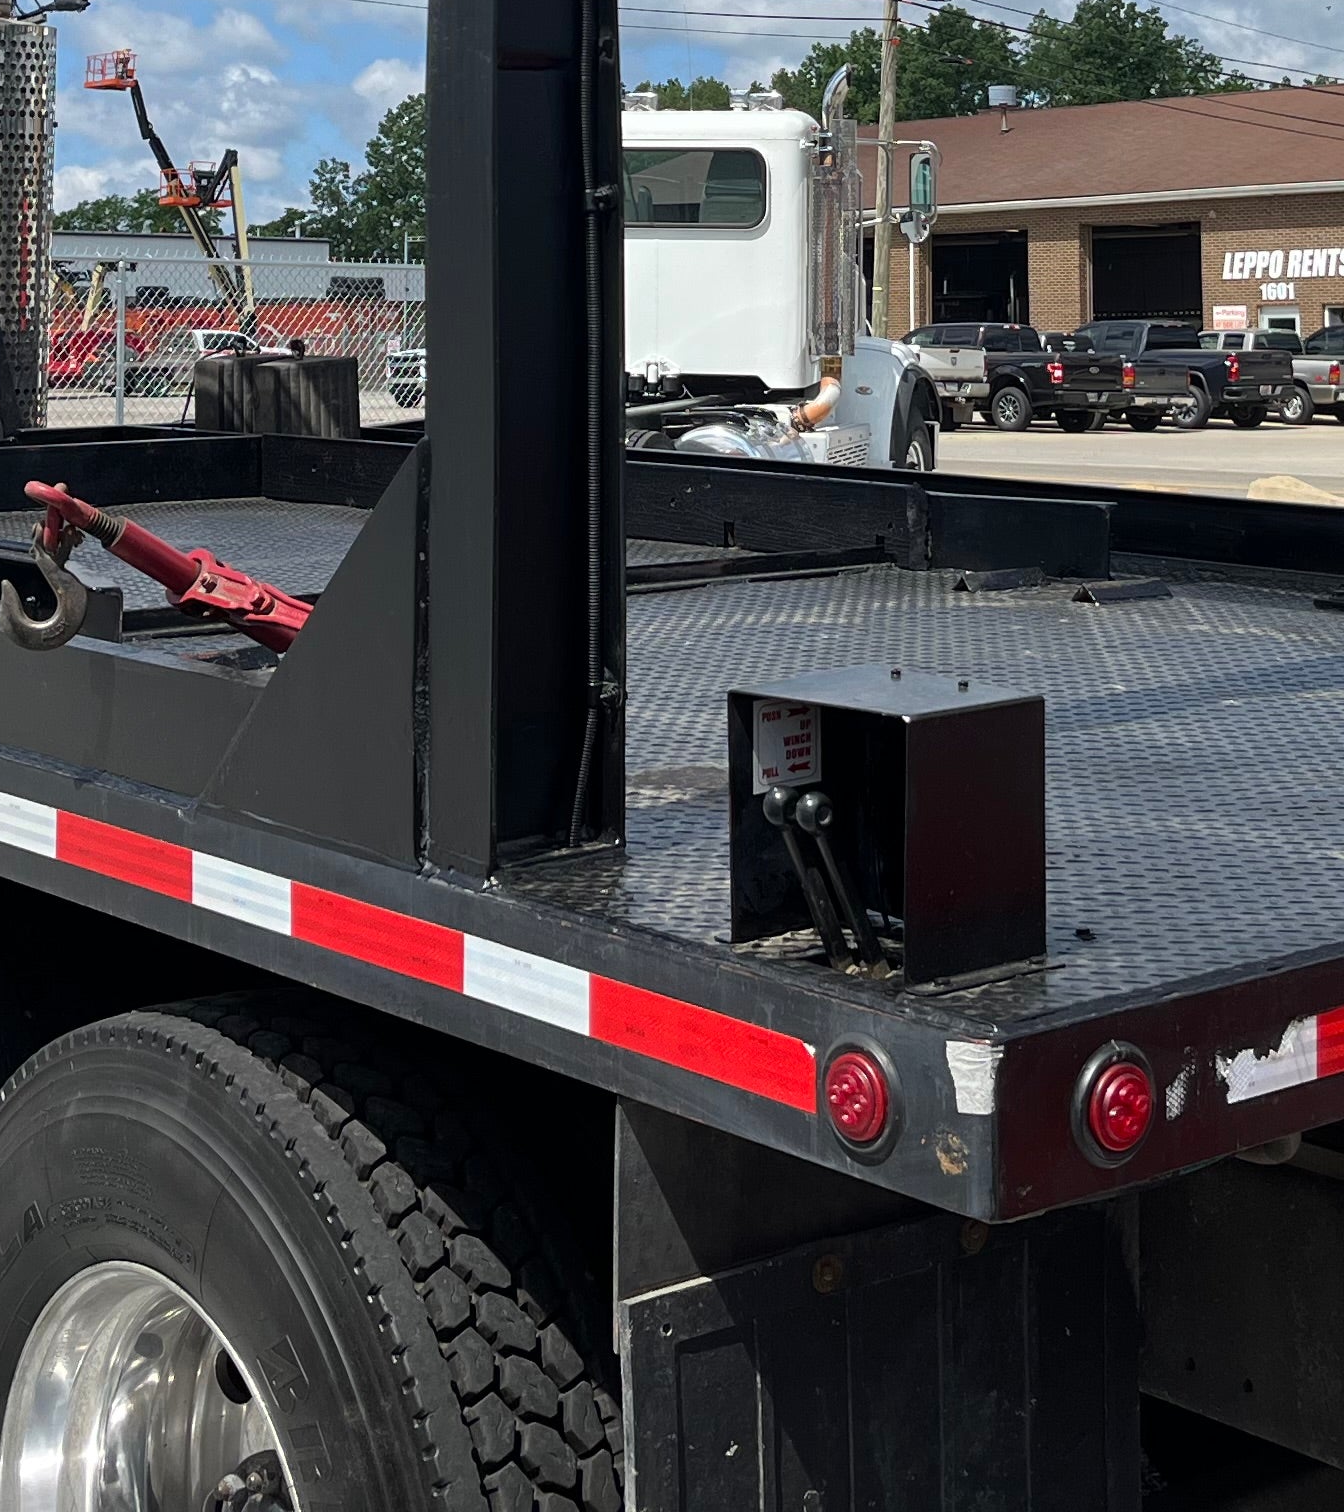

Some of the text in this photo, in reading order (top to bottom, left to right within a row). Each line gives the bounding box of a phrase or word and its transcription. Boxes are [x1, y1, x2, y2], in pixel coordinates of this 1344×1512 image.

[1222, 249, 1284, 280] LEPPO
[1259, 282, 1295, 300] 1601
[762, 710, 781, 723] PUSH
[800, 719, 811, 730] UP
[783, 732, 811, 746] WINCH
[786, 746, 811, 760] DOWN
